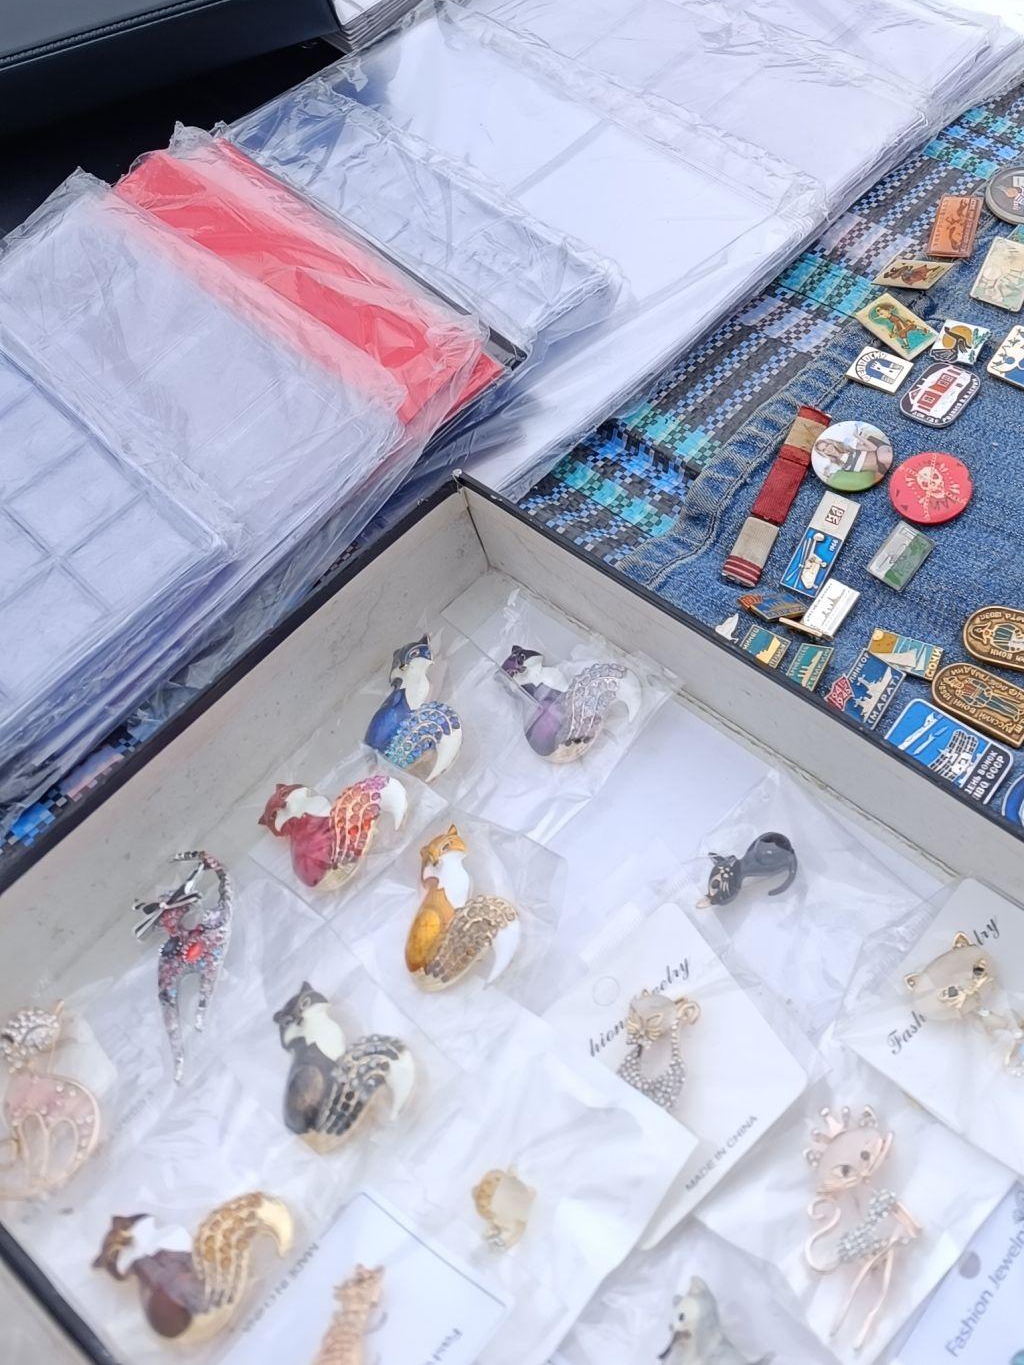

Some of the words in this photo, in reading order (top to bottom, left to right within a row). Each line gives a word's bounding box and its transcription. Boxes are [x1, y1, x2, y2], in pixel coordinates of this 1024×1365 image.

[924, 646, 944, 680] СОЧИ
[986, 755, 1005, 780] СССР
[886, 1010, 927, 1056] Fash
[685, 1158, 717, 1191] MADE
[726, 1114, 759, 1151] CHINA
[944, 1289, 995, 1358] Fashion
